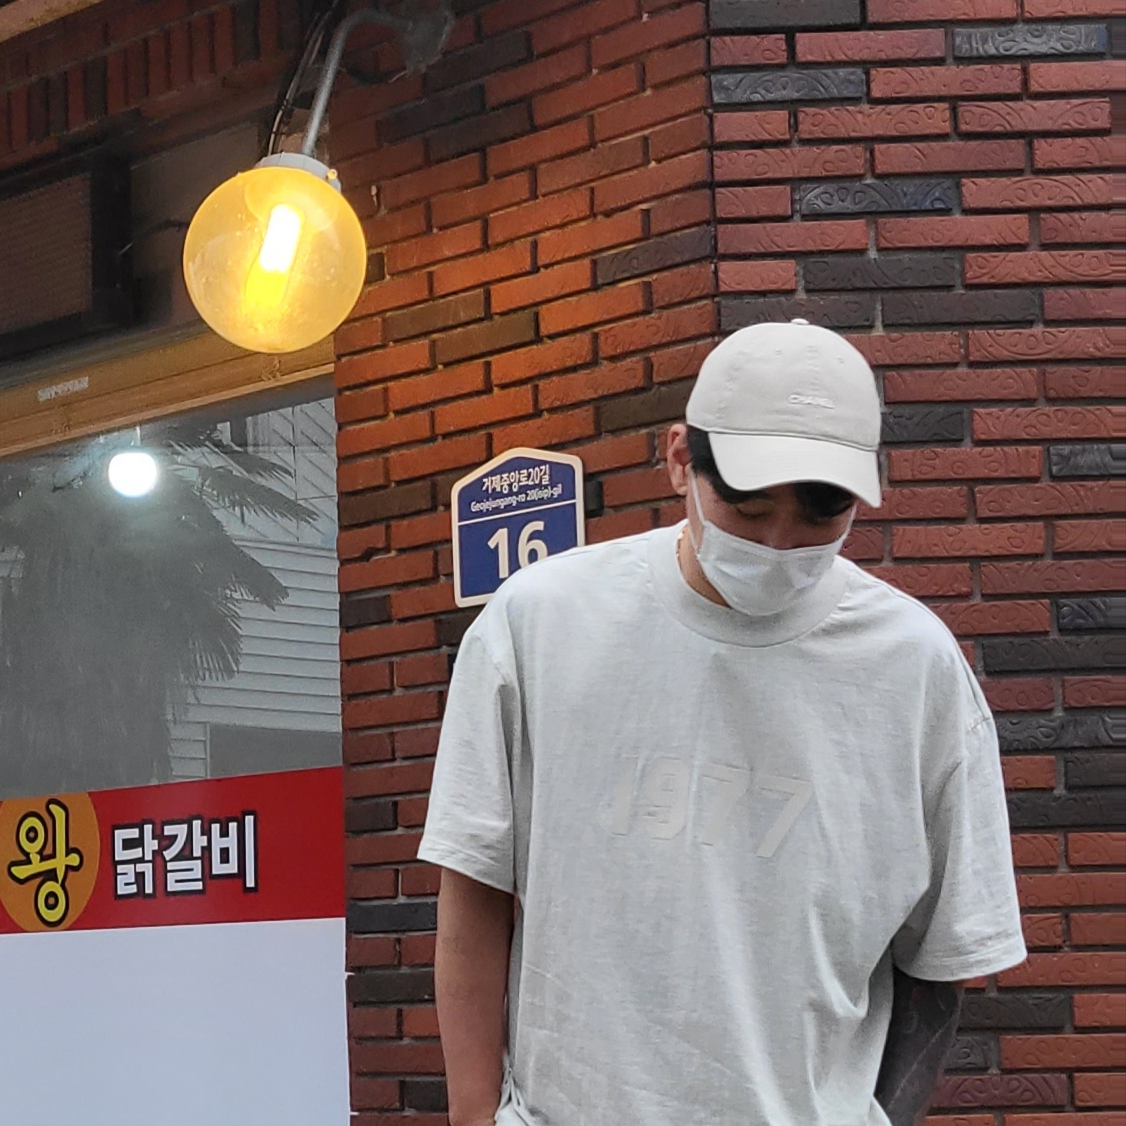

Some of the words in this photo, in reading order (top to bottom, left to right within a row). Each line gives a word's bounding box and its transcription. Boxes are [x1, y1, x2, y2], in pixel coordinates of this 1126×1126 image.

[482, 464, 550, 494] 거제중앙로20길
[487, 520, 549, 579] 16
[111, 810, 259, 898] 닭갈비
